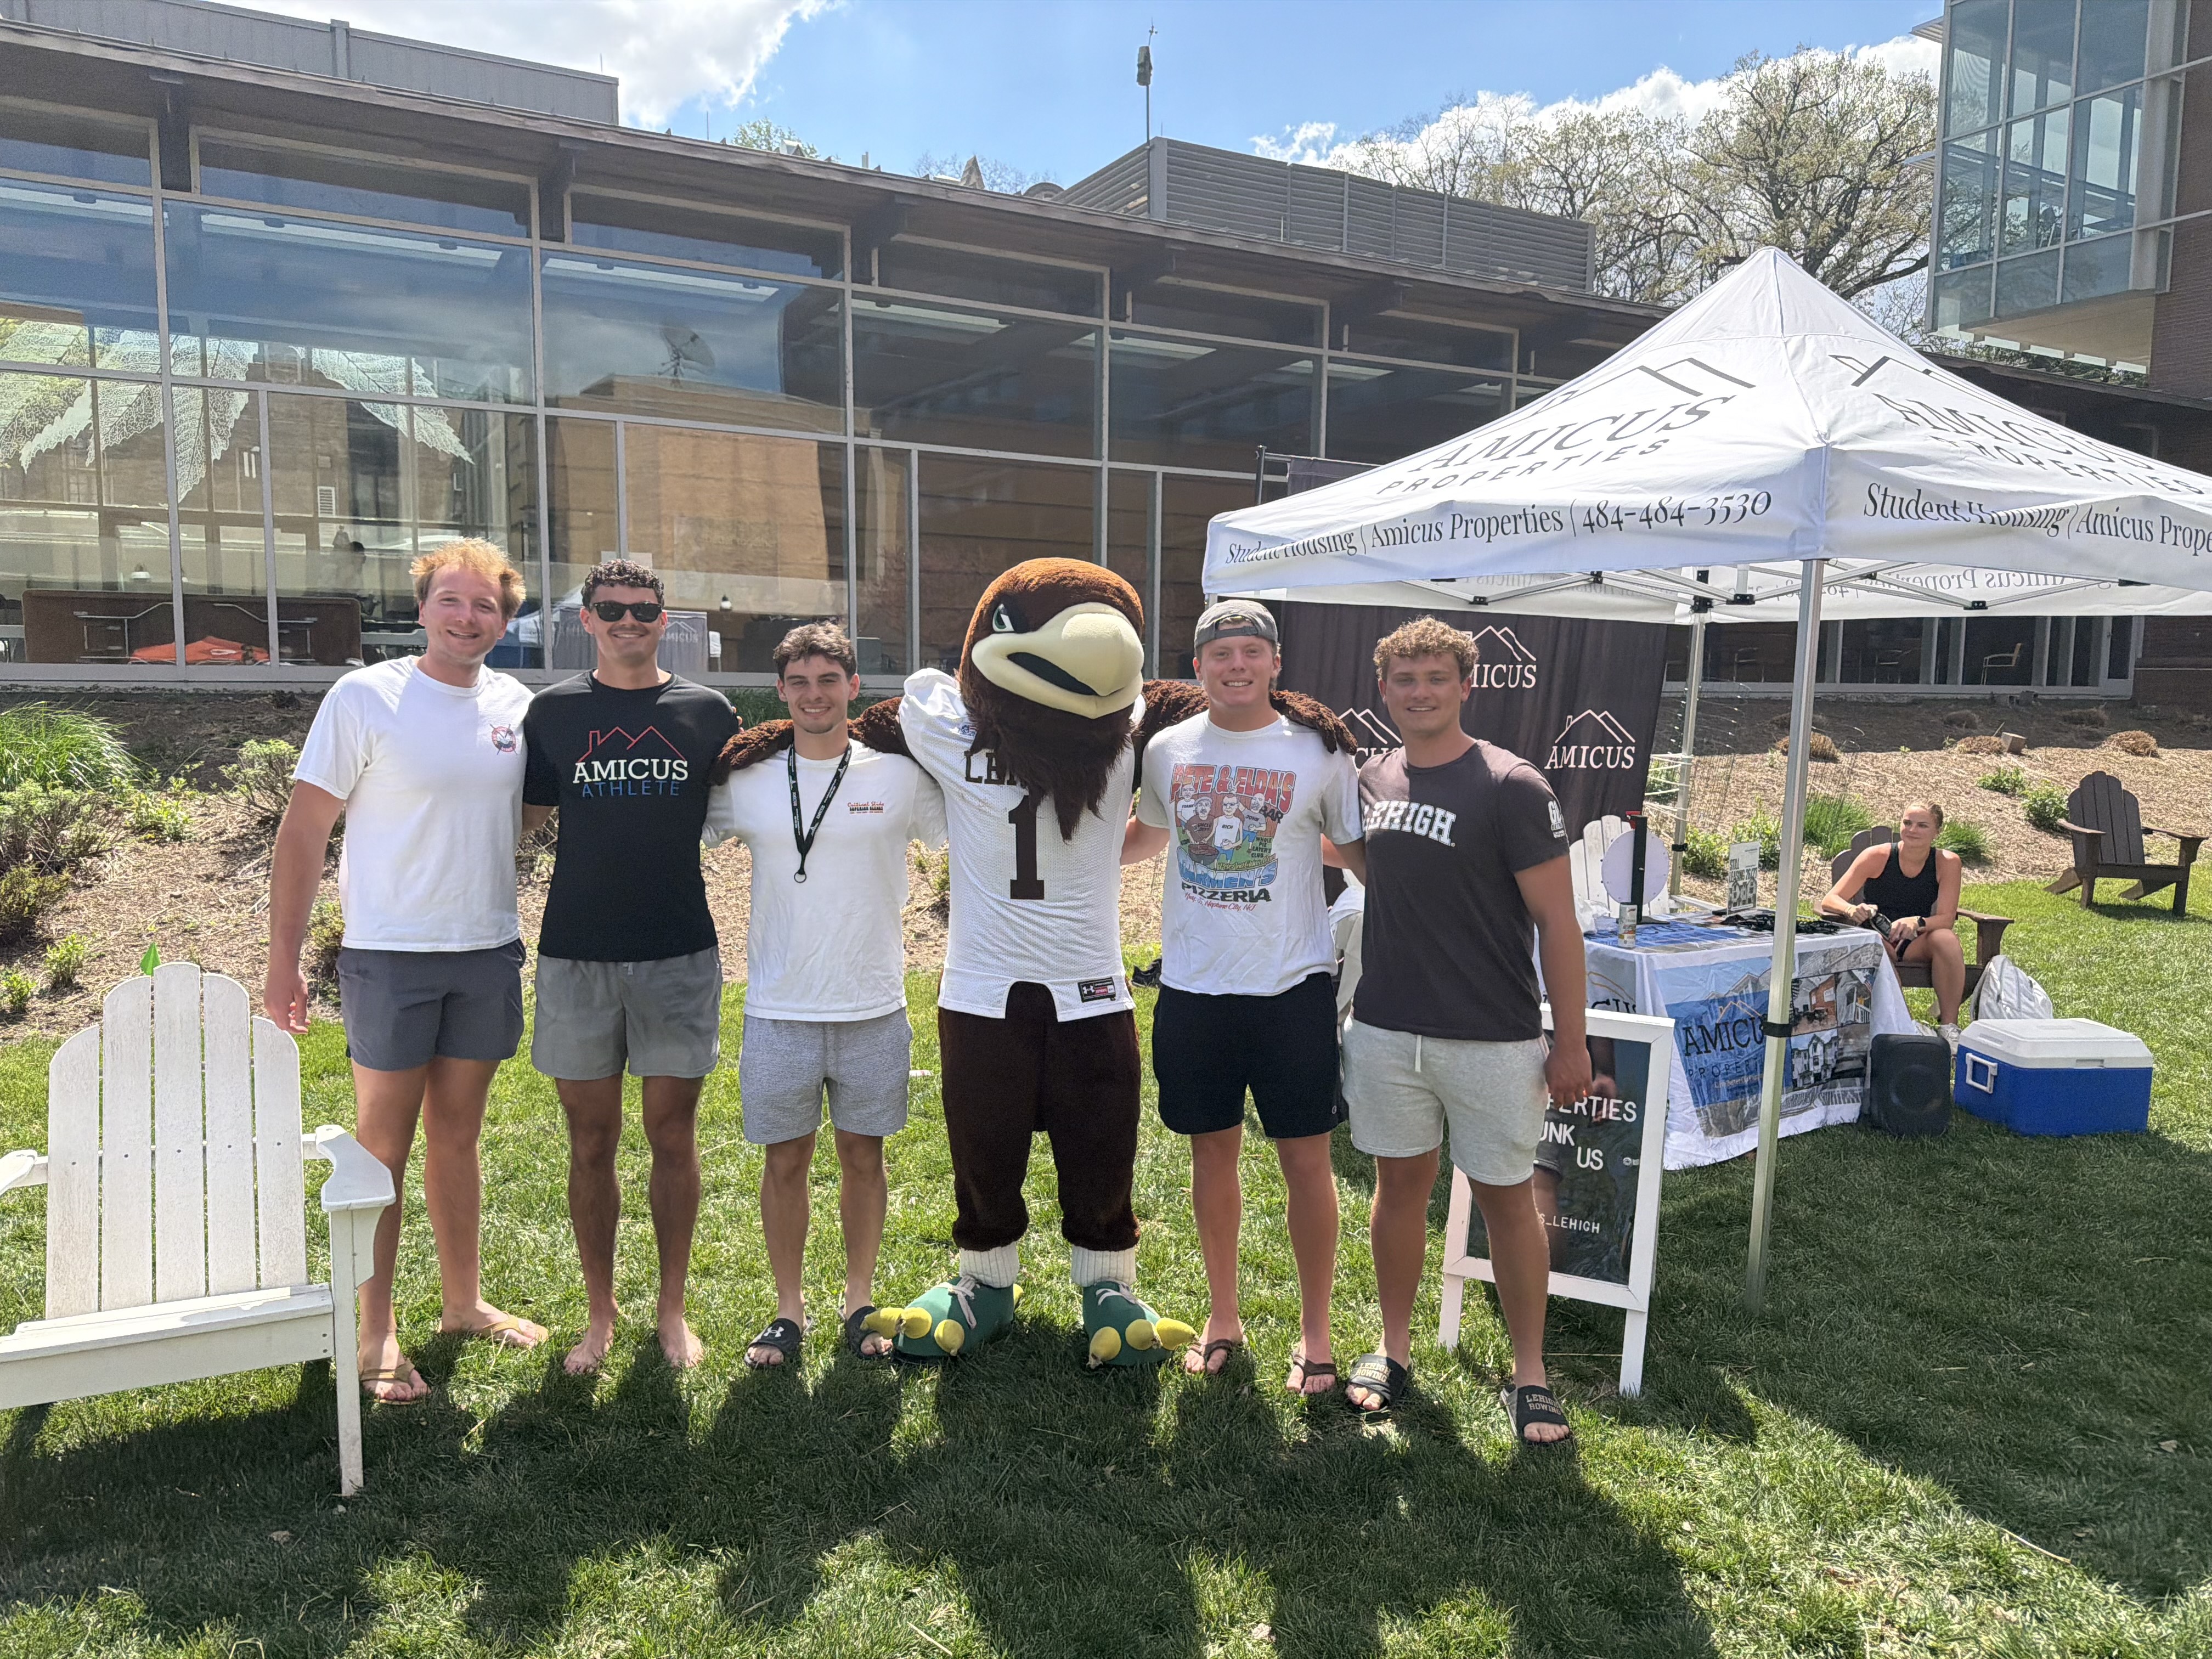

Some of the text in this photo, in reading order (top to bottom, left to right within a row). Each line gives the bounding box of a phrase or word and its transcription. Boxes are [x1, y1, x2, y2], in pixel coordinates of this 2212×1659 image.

[1408, 395, 1736, 472] AMICUS
[1376, 439, 1669, 494] PROPERTIES
[1929, 435, 2204, 494] PROPERTIES
[1372, 518, 1443, 548] Amicus
[1451, 504, 1564, 544] Properties
[1582, 491, 1771, 533] 484-484-3530
[1864, 482, 1970, 522] Student
[2075, 506, 2154, 544] Amicus
[660, 630, 698, 643] MICUS
[1544, 746, 1635, 769] AMICUS
[573, 758, 689, 783] AMICUS
[582, 780, 680, 798] ATHLETE
[1169, 763, 1296, 814] PETE & ELDA'S
[1260, 805, 1284, 824] BAR
[1363, 800, 1457, 847] LEHIGH
[1008, 795, 1044, 900] 1
[1177, 847, 1278, 890] CARMEN'S
[1729, 858, 1740, 871] STILL
[1729, 869, 1745, 883] LEASING
[1181, 881, 1272, 902] PIZZERIA
[1683, 1016, 1764, 1056] AMICU
[1577, 1146, 1604, 1170] US
[1356, 1369, 1387, 1383] ROWING
[1359, 1362, 1391, 1376] LEHIGH
[1528, 1403, 1561, 1415] ROWING
